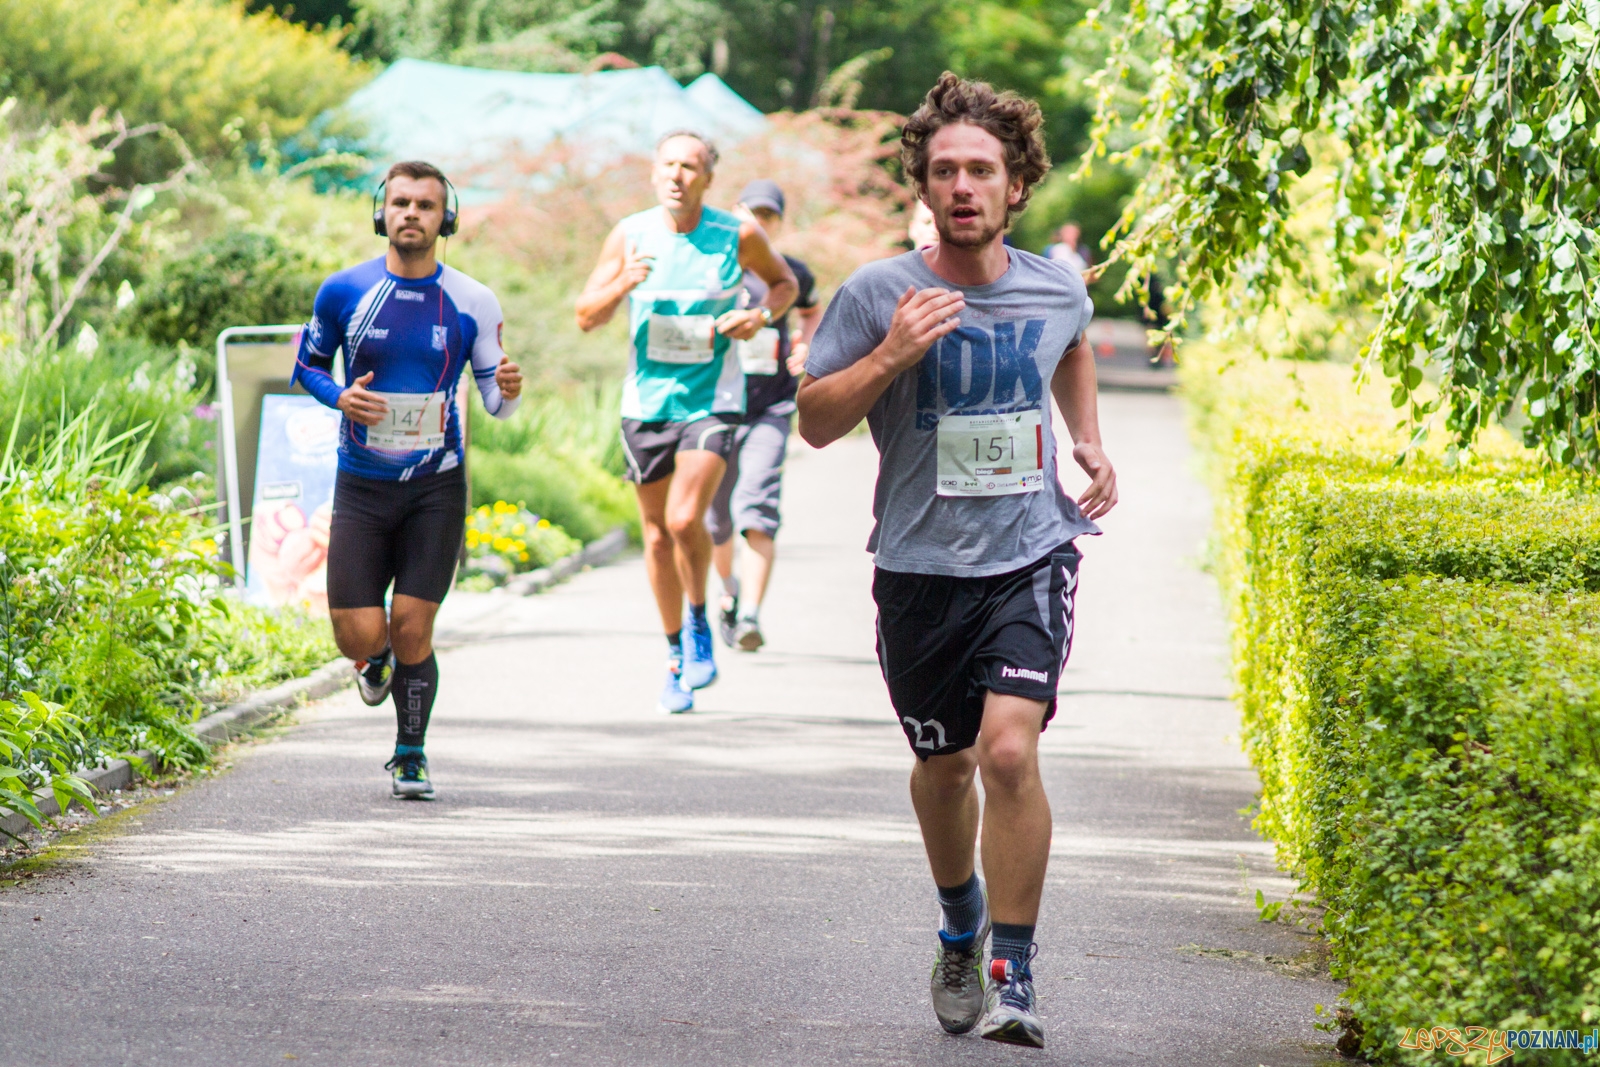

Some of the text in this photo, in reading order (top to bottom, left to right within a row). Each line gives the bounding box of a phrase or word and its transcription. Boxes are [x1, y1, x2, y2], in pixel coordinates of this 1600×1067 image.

[391, 408, 425, 427] 147
[972, 436, 1014, 462] 151
[1002, 666, 1048, 684] hummel
